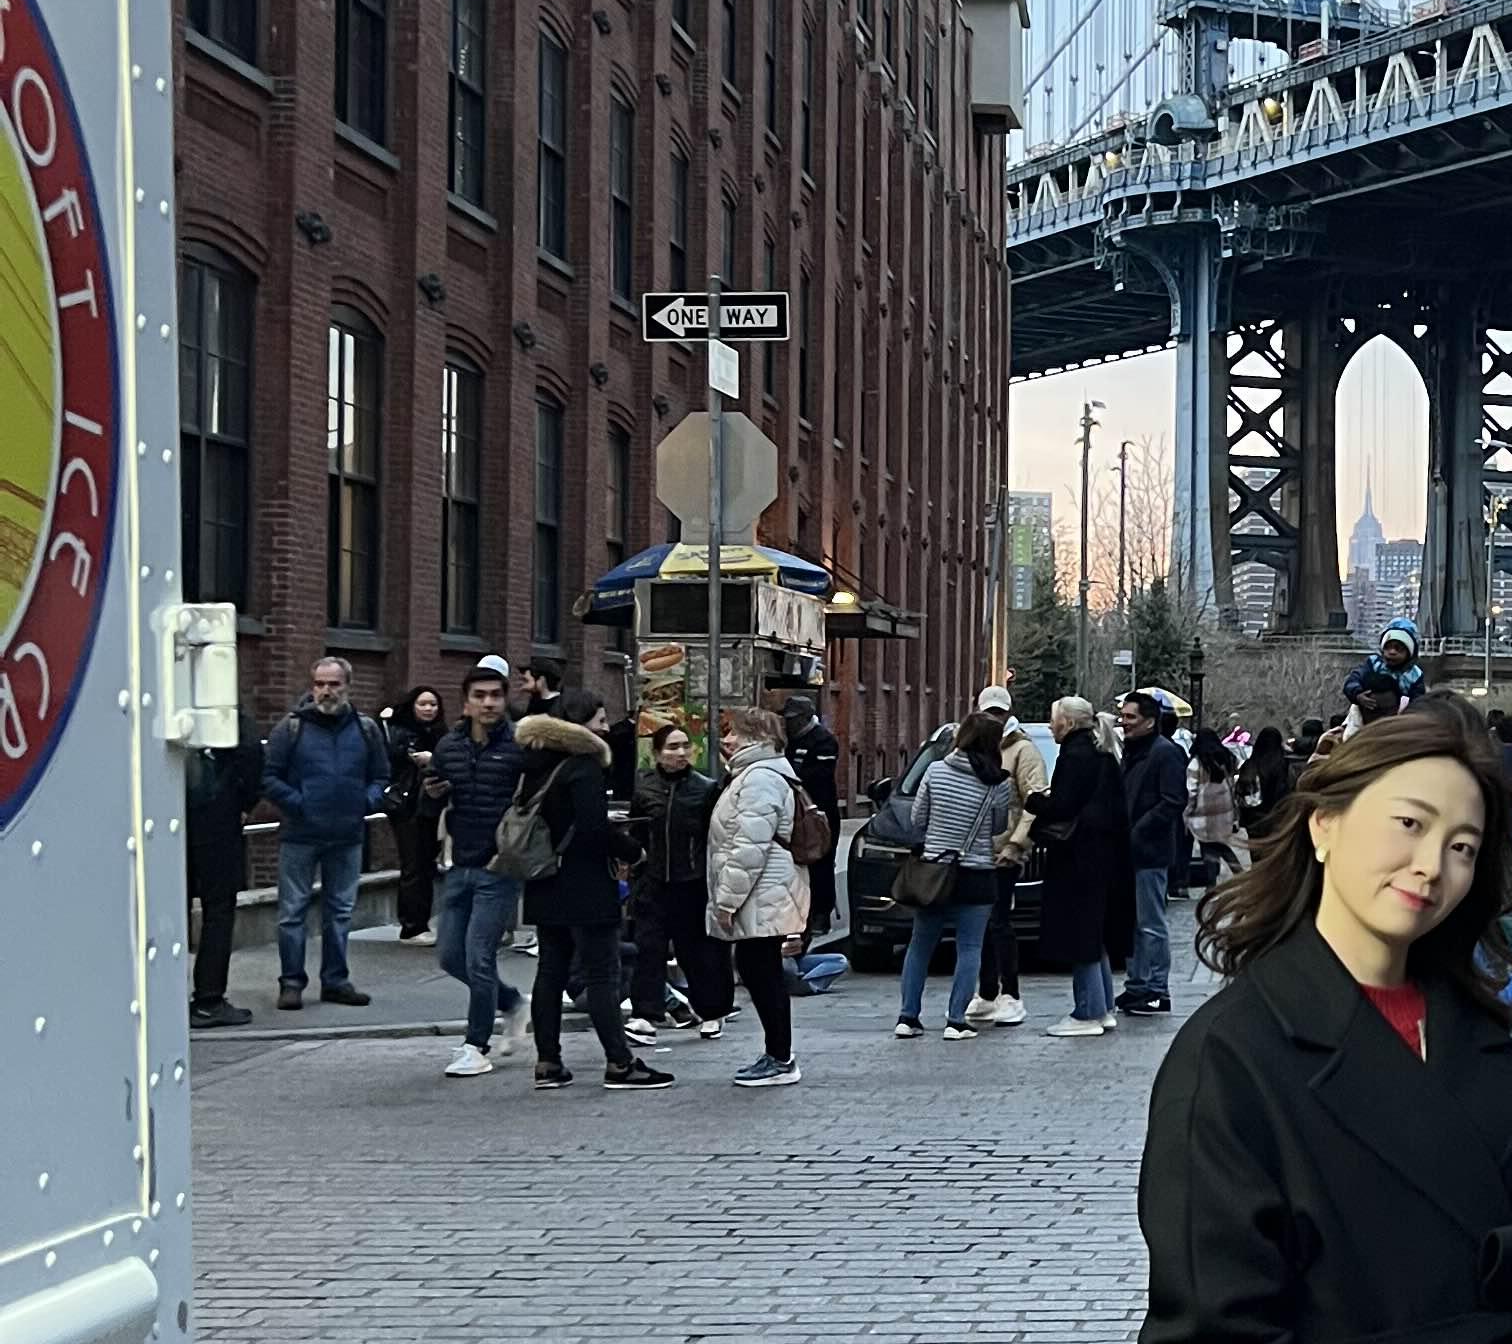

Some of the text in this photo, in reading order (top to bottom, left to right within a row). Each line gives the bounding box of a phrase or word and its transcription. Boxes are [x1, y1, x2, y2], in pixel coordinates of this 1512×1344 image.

[667, 308, 768, 326] ONE WAY
[50, 410, 103, 597] ICE
